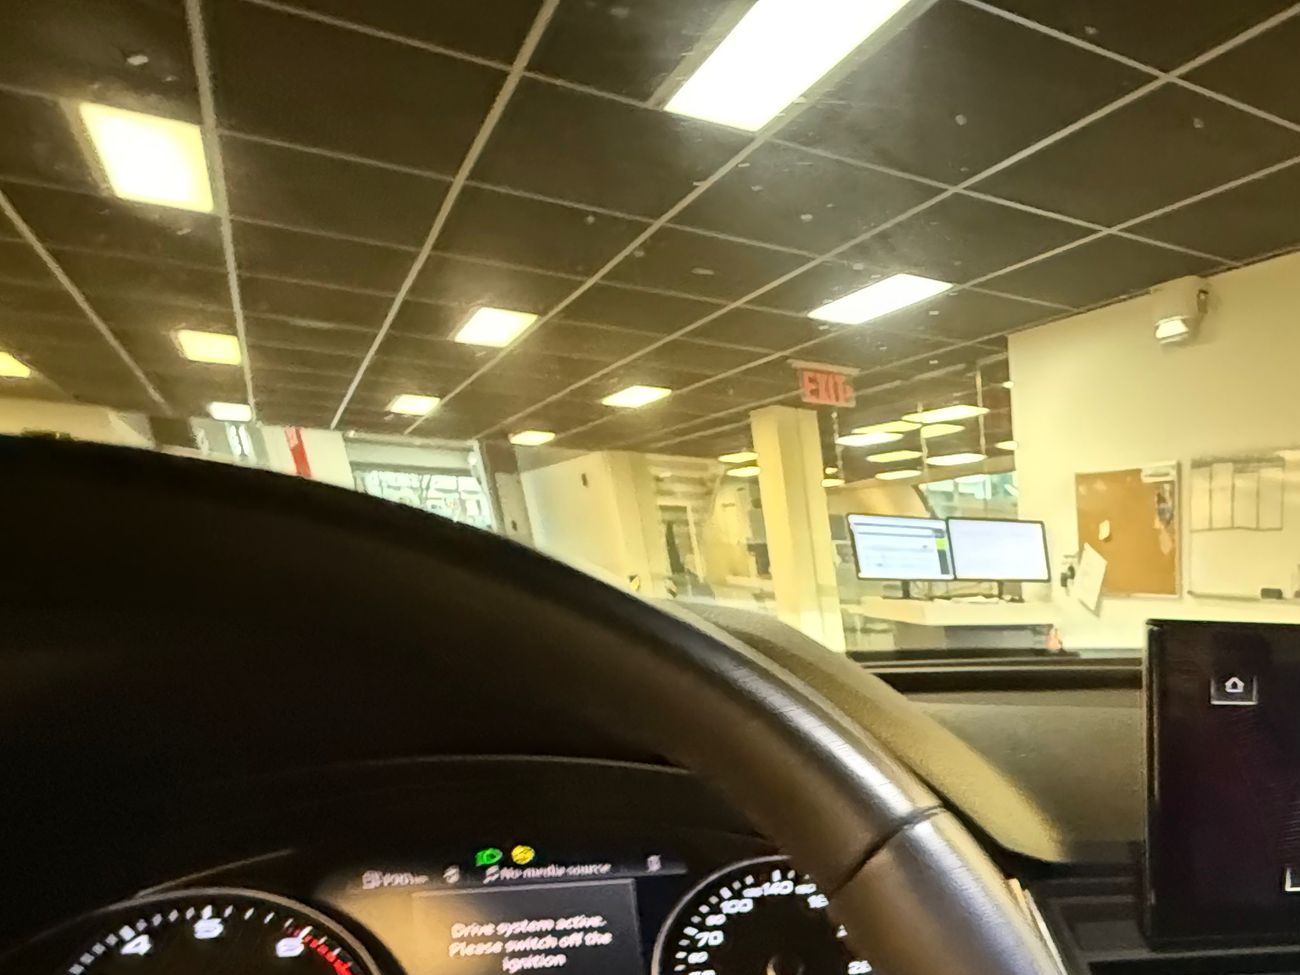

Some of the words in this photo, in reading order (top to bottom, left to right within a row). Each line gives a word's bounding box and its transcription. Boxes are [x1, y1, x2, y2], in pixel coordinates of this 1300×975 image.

[500, 866, 522, 880] No
[523, 863, 565, 878] media
[566, 863, 611, 877] source
[193, 917, 225, 939] 5
[451, 922, 496, 939] Drive
[496, 918, 555, 938] system
[695, 930, 724, 947] 70
[120, 934, 152, 956] 4
[275, 937, 304, 957] 6
[449, 941, 503, 957] Please
[504, 934, 558, 953] switch
[558, 931, 584, 948] off
[584, 930, 613, 946] the
[502, 953, 567, 974] ignition
